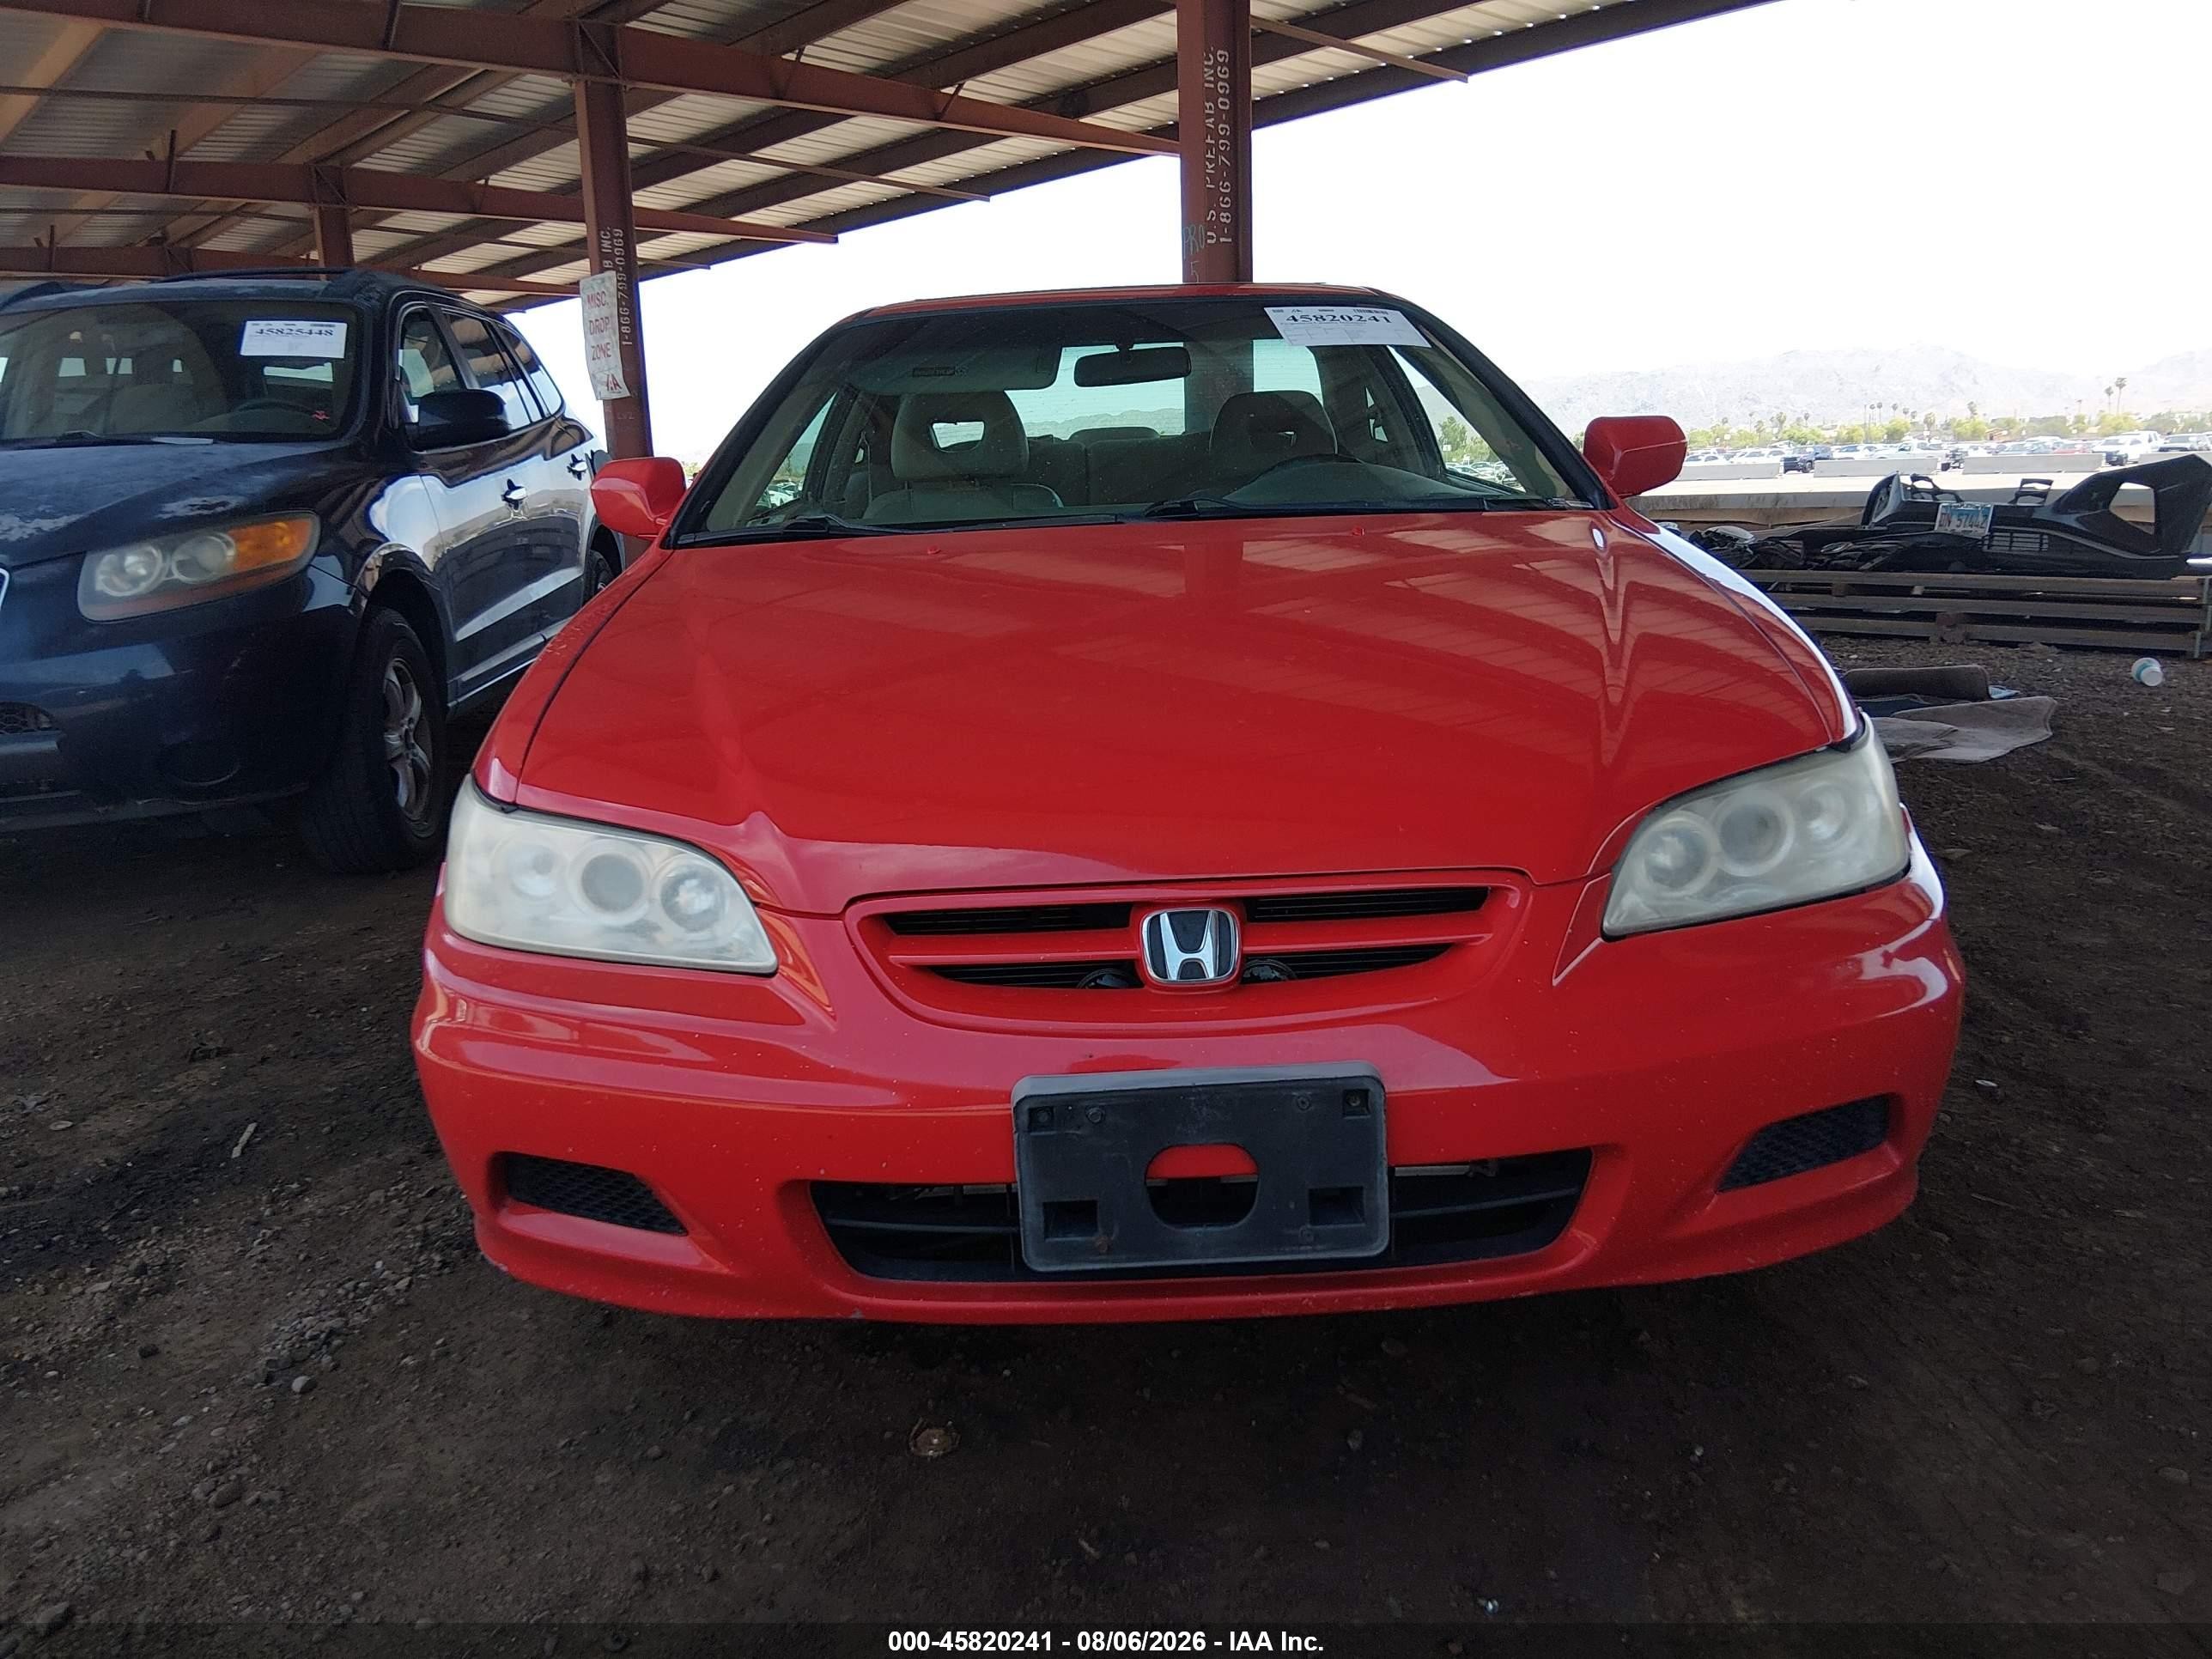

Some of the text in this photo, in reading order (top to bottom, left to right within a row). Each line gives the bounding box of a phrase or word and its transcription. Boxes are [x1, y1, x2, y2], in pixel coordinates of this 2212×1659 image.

[1203, 46, 1217, 244] U.S. PREFAB INC.
[1217, 49, 1232, 244] 1-866-799-0969
[601, 226, 612, 253] INC.
[612, 228, 632, 345] 1-866-799-0969
[586, 290, 609, 310] MISC.
[589, 316, 611, 336] DROP
[1285, 313, 1393, 324] 45820241
[255, 328, 334, 337] 45825448
[591, 343, 612, 361] ZONE
